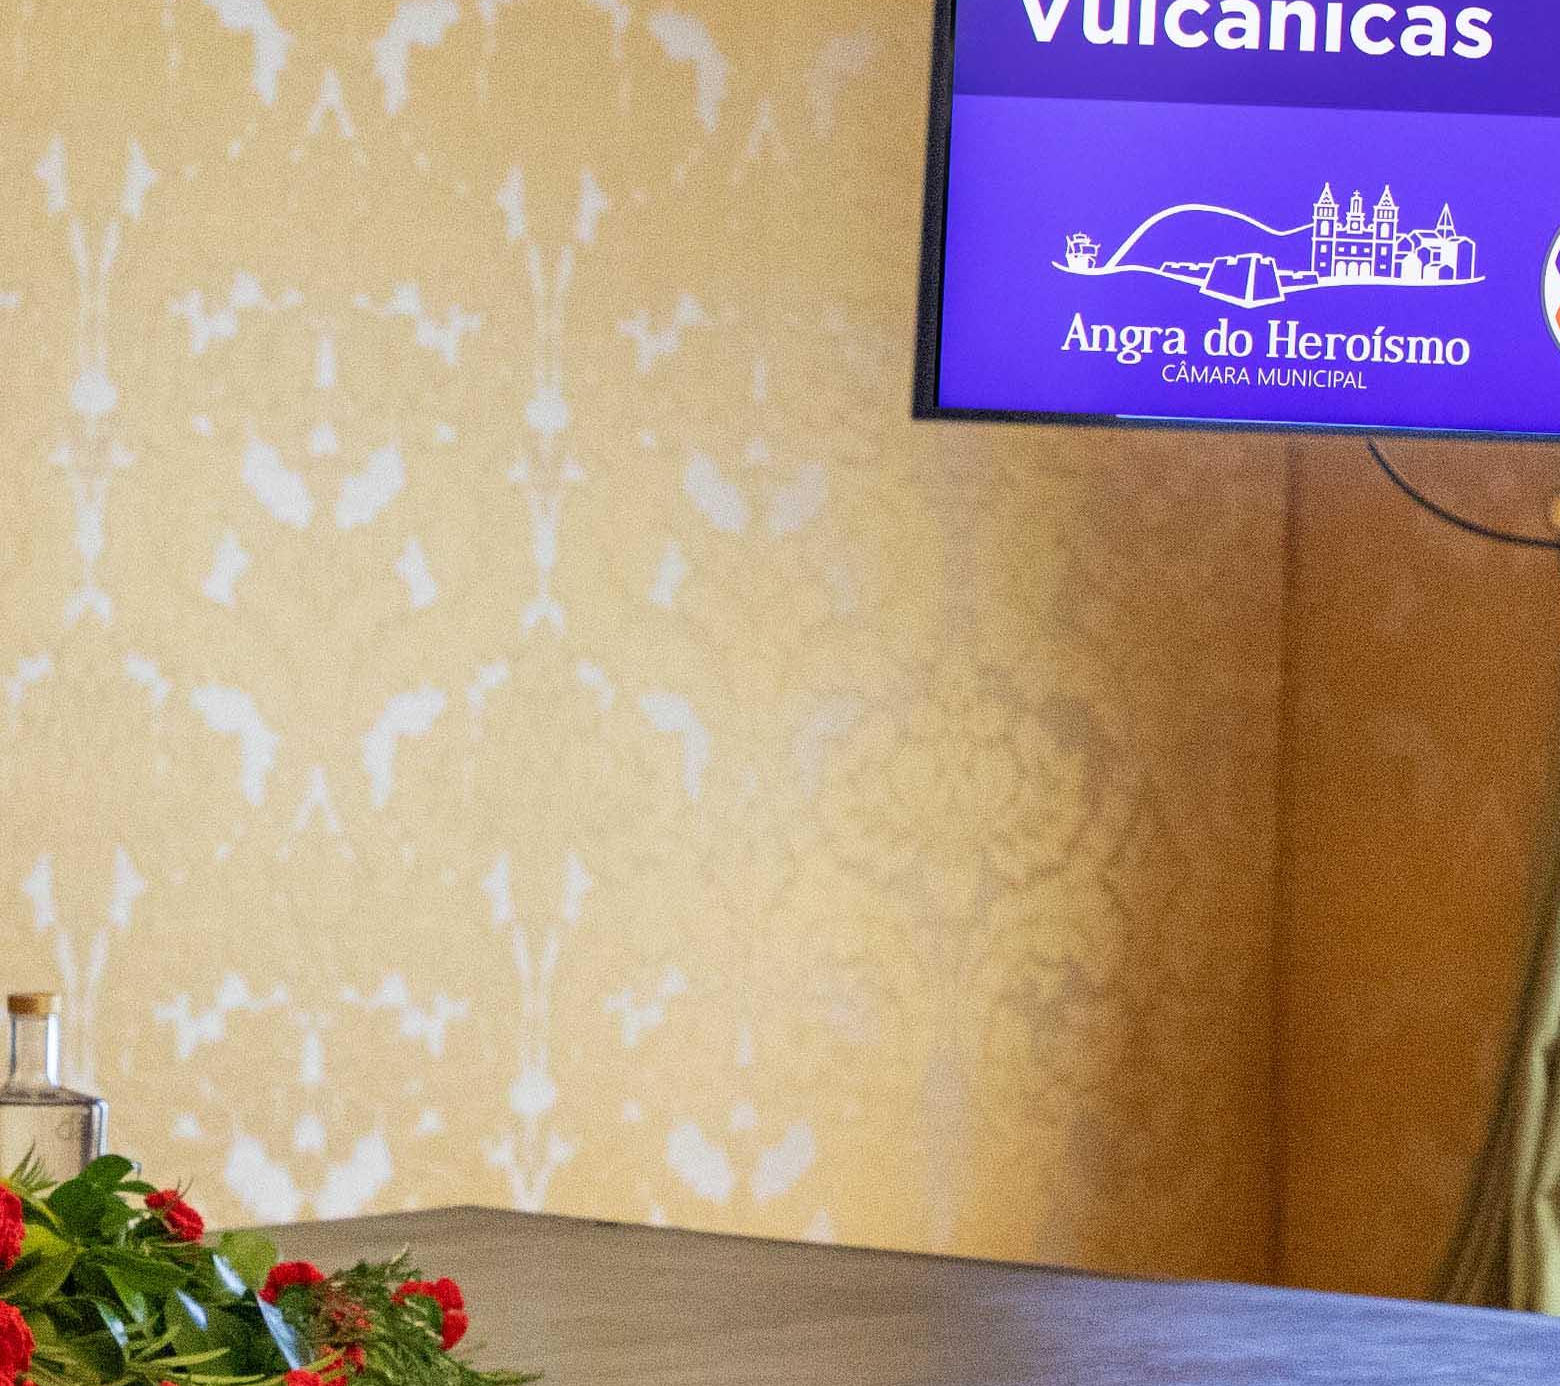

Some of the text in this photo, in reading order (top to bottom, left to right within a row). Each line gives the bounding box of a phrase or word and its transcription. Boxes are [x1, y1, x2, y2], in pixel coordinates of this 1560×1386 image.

[1061, 312, 1470, 365] Angra do Heroísmo
[1161, 360, 1367, 389] CÂMARA MUNICIPAL
